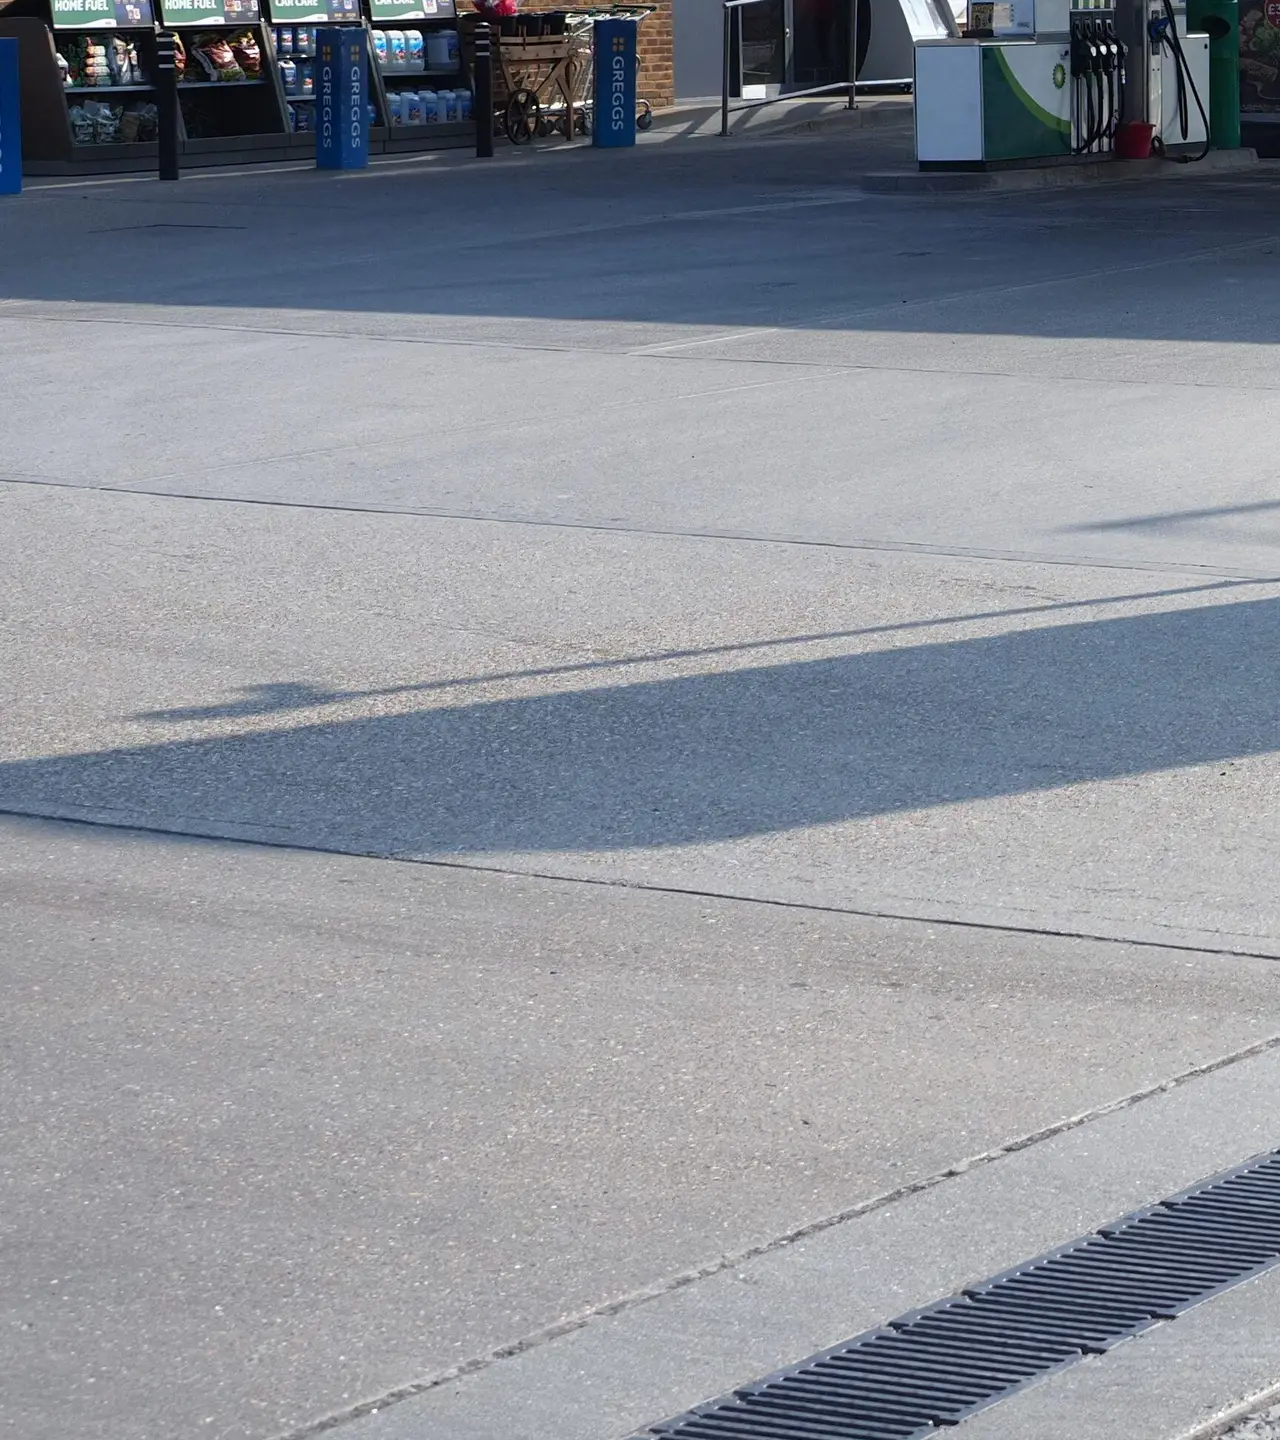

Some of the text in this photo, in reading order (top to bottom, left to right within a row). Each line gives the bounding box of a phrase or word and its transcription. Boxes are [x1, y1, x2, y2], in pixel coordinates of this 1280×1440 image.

[322, 66, 331, 149] GREGGS
[351, 65, 361, 149] GREGGS
[612, 56, 625, 131] GREGGS
